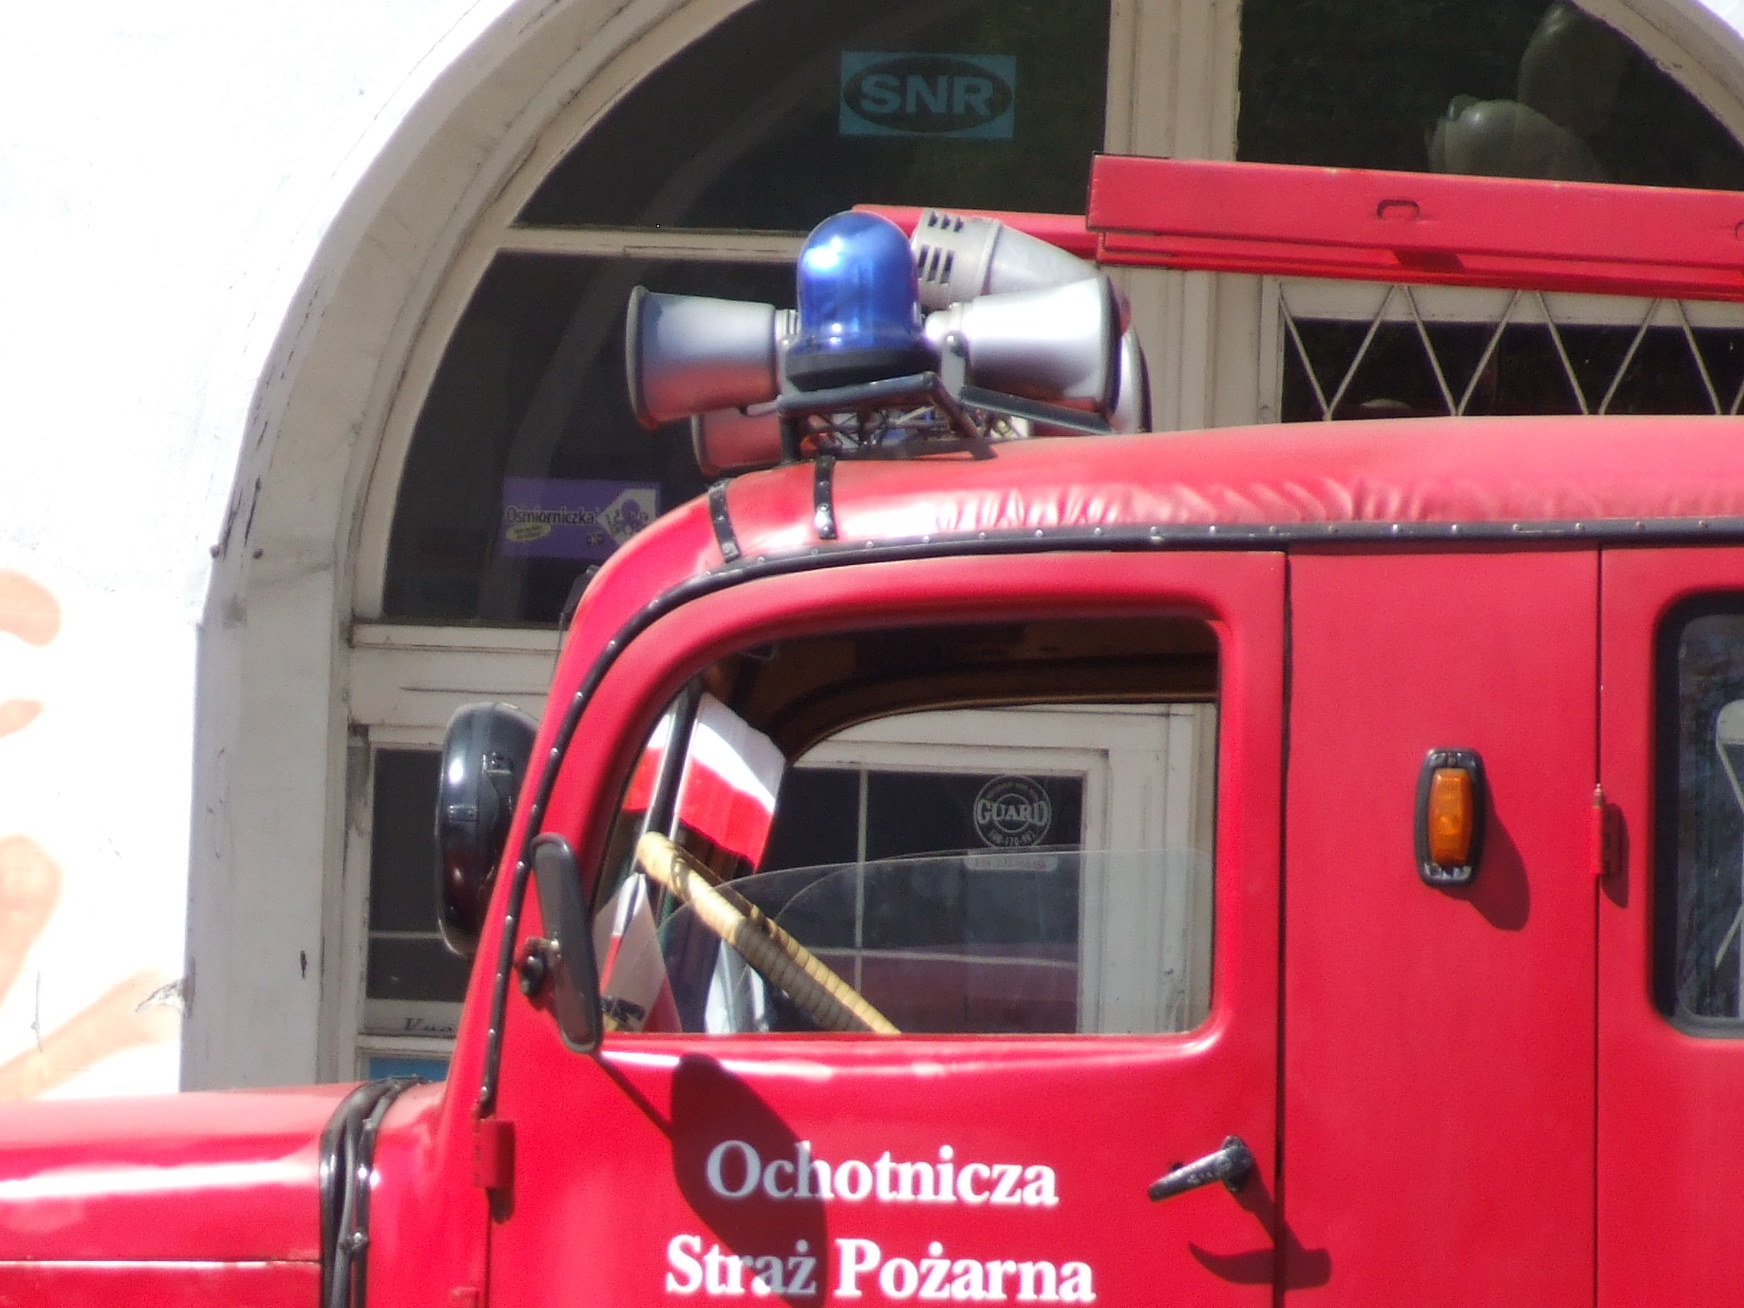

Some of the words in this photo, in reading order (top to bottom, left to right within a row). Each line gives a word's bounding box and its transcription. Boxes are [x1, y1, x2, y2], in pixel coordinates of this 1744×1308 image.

[861, 73, 995, 118] SNR
[977, 799, 1048, 826] GUARD
[705, 1140, 1058, 1206] Ochotnicza
[666, 1233, 817, 1296] Straż
[835, 1238, 1097, 1303] Pożarna
